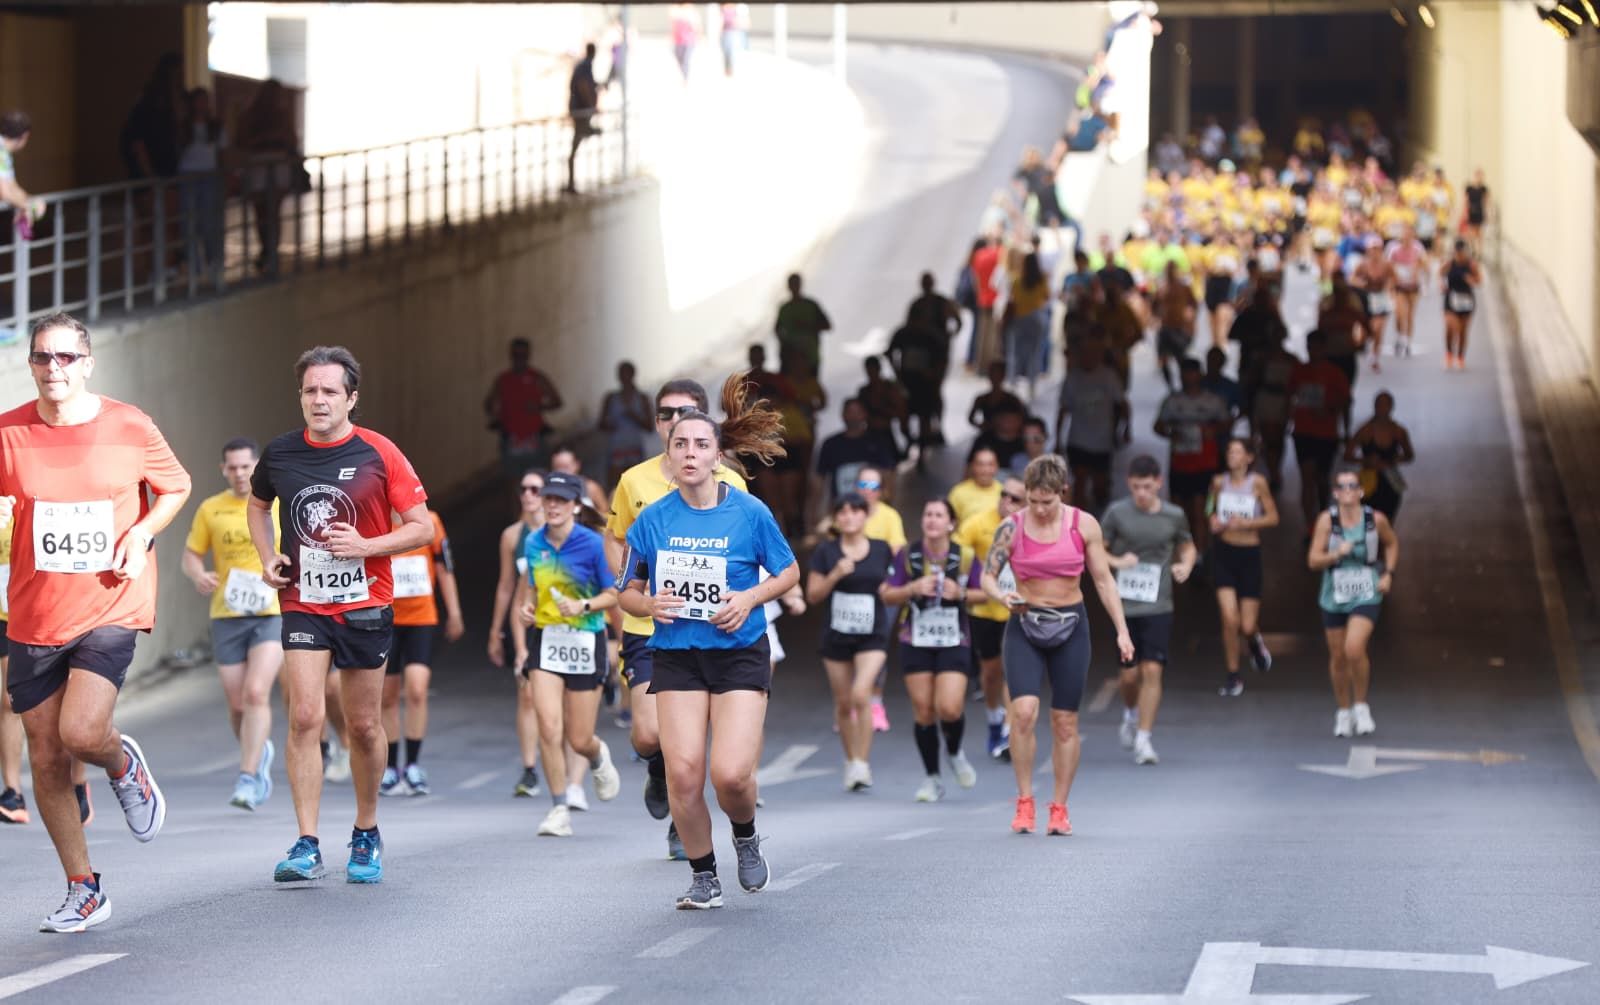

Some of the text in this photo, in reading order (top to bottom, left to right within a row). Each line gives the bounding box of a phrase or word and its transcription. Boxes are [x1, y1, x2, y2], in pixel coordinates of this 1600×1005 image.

[42, 531, 108, 555] 6459
[669, 536, 729, 550] mayoral
[303, 567, 364, 588] 11204
[229, 588, 265, 609] 5101
[547, 645, 590, 663] 2605
